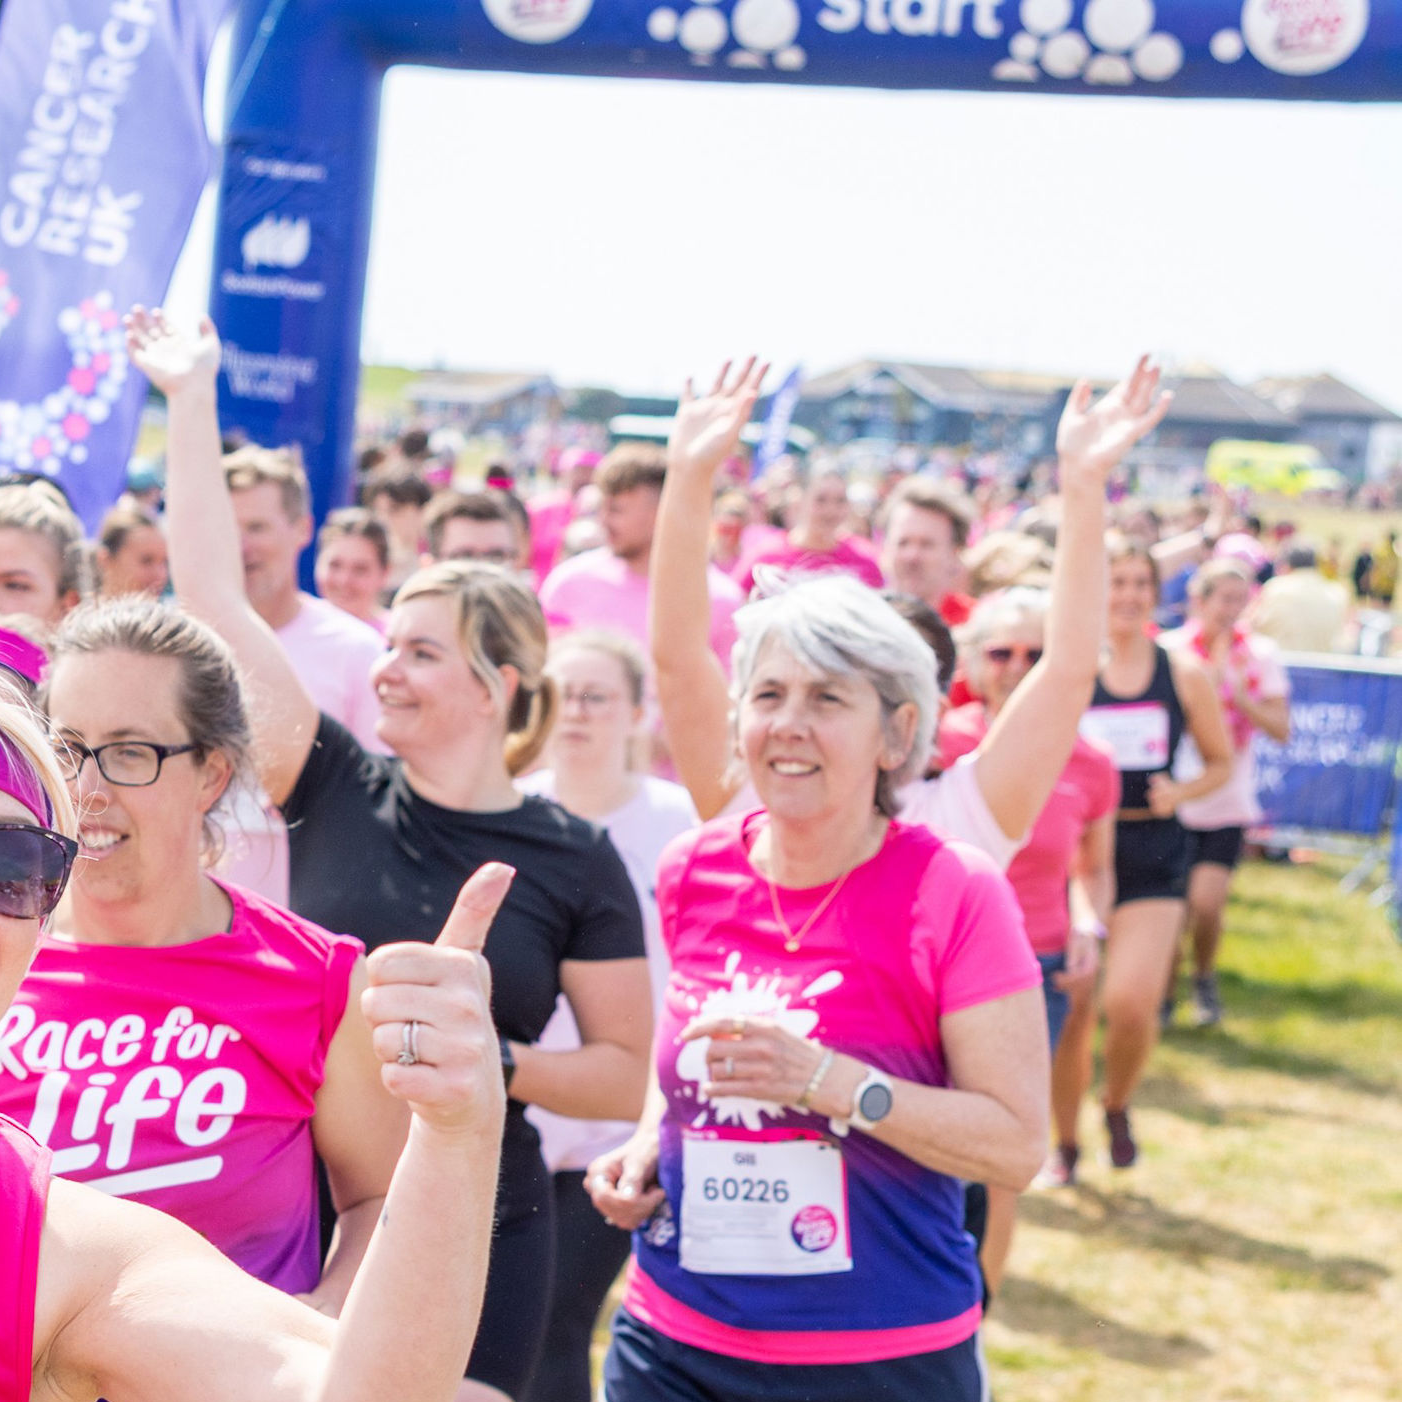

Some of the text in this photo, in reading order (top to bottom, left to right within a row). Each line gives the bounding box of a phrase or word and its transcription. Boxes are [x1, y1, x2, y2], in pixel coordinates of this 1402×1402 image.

[0, 22, 94, 248] CANCER
[37, 0, 157, 257] RESEARCH
[83, 190, 143, 266] UK
[151, 1005, 241, 1063] for
[28, 1066, 247, 1172] Life
[703, 1177, 790, 1203] 60226
